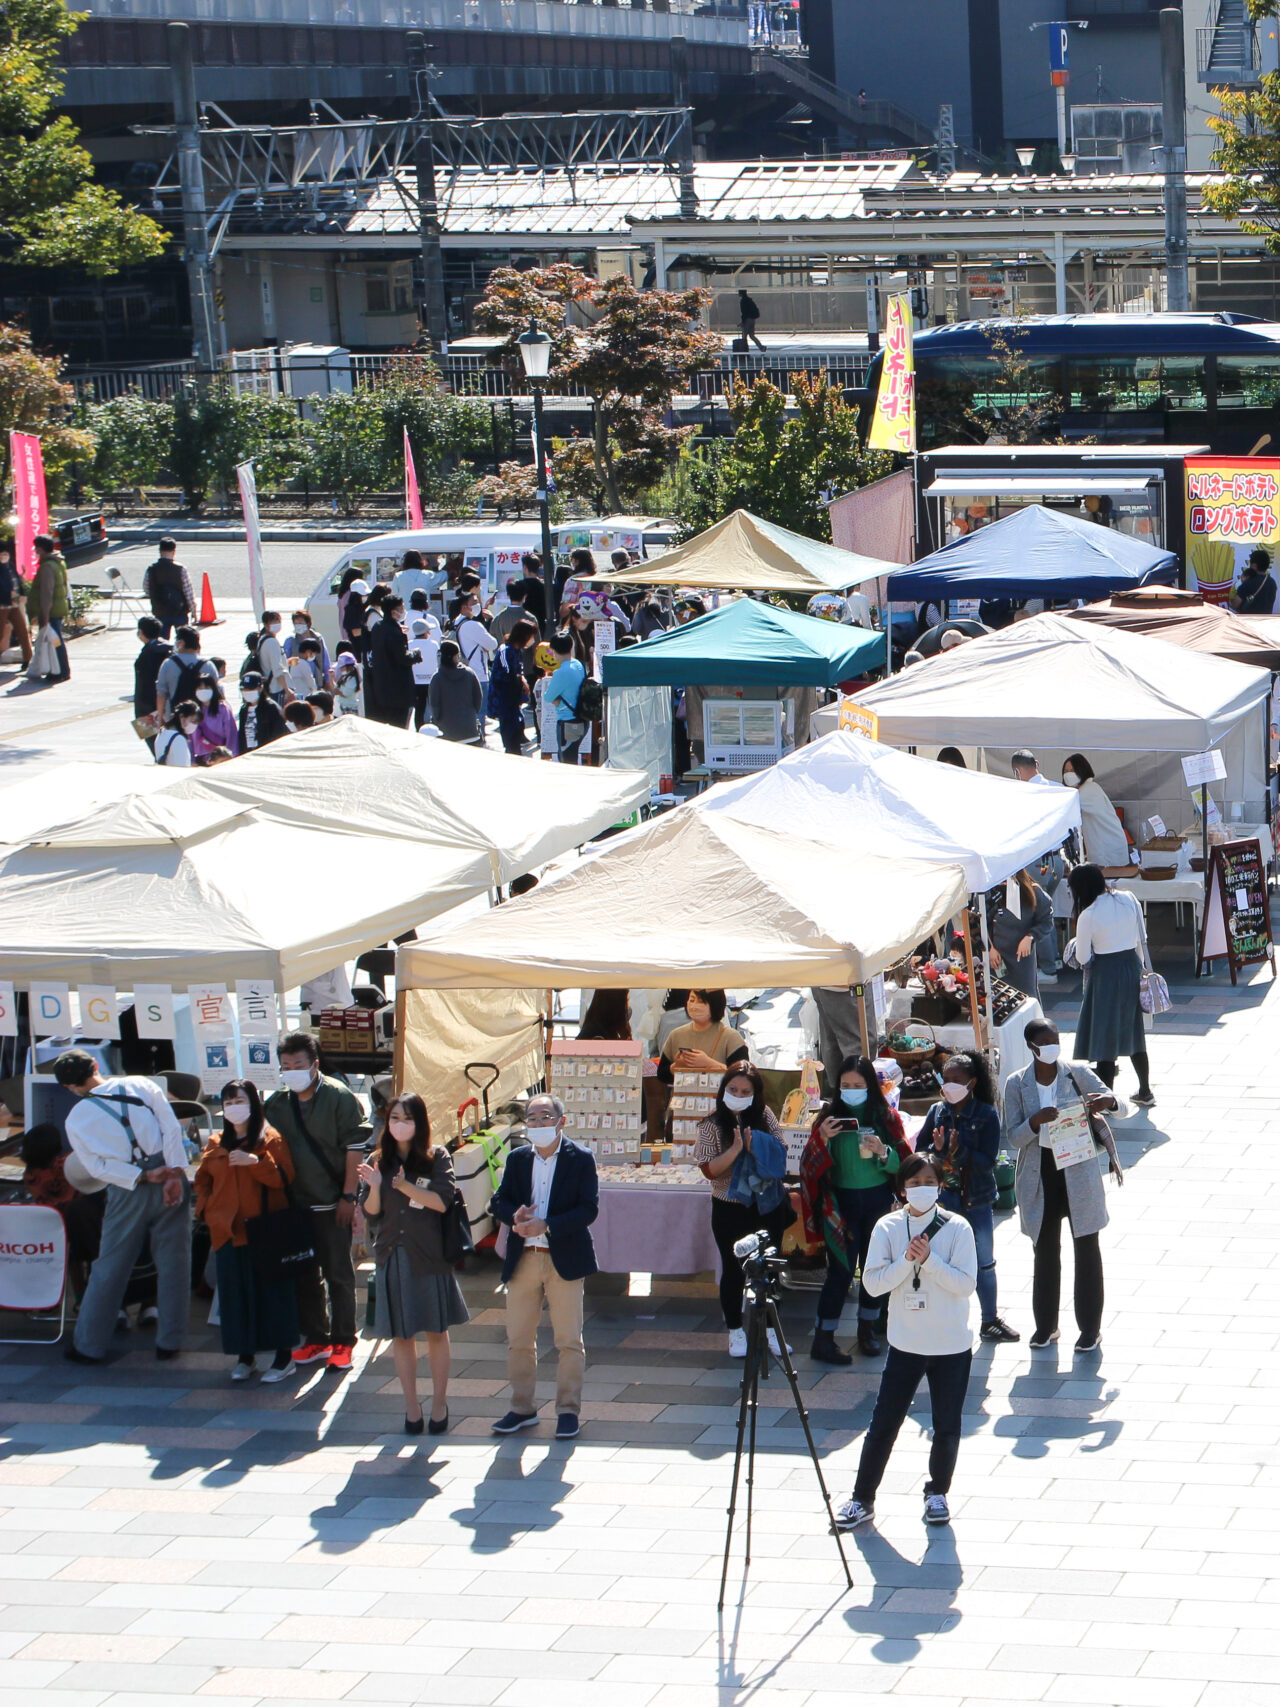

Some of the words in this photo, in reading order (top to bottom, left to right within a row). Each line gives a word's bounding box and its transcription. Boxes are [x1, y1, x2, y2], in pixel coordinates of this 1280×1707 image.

[1061, 28, 1068, 64] P
[841, 151, 908, 160] ヨドシカメラ
[1189, 473, 1278, 500] トルネードポテト
[1191, 504, 1278, 536] ロングポテト
[41, 995, 62, 1019] D
[88, 998, 110, 1023] G
[196, 994, 226, 1025] 宣
[243, 990, 270, 1021] 言
